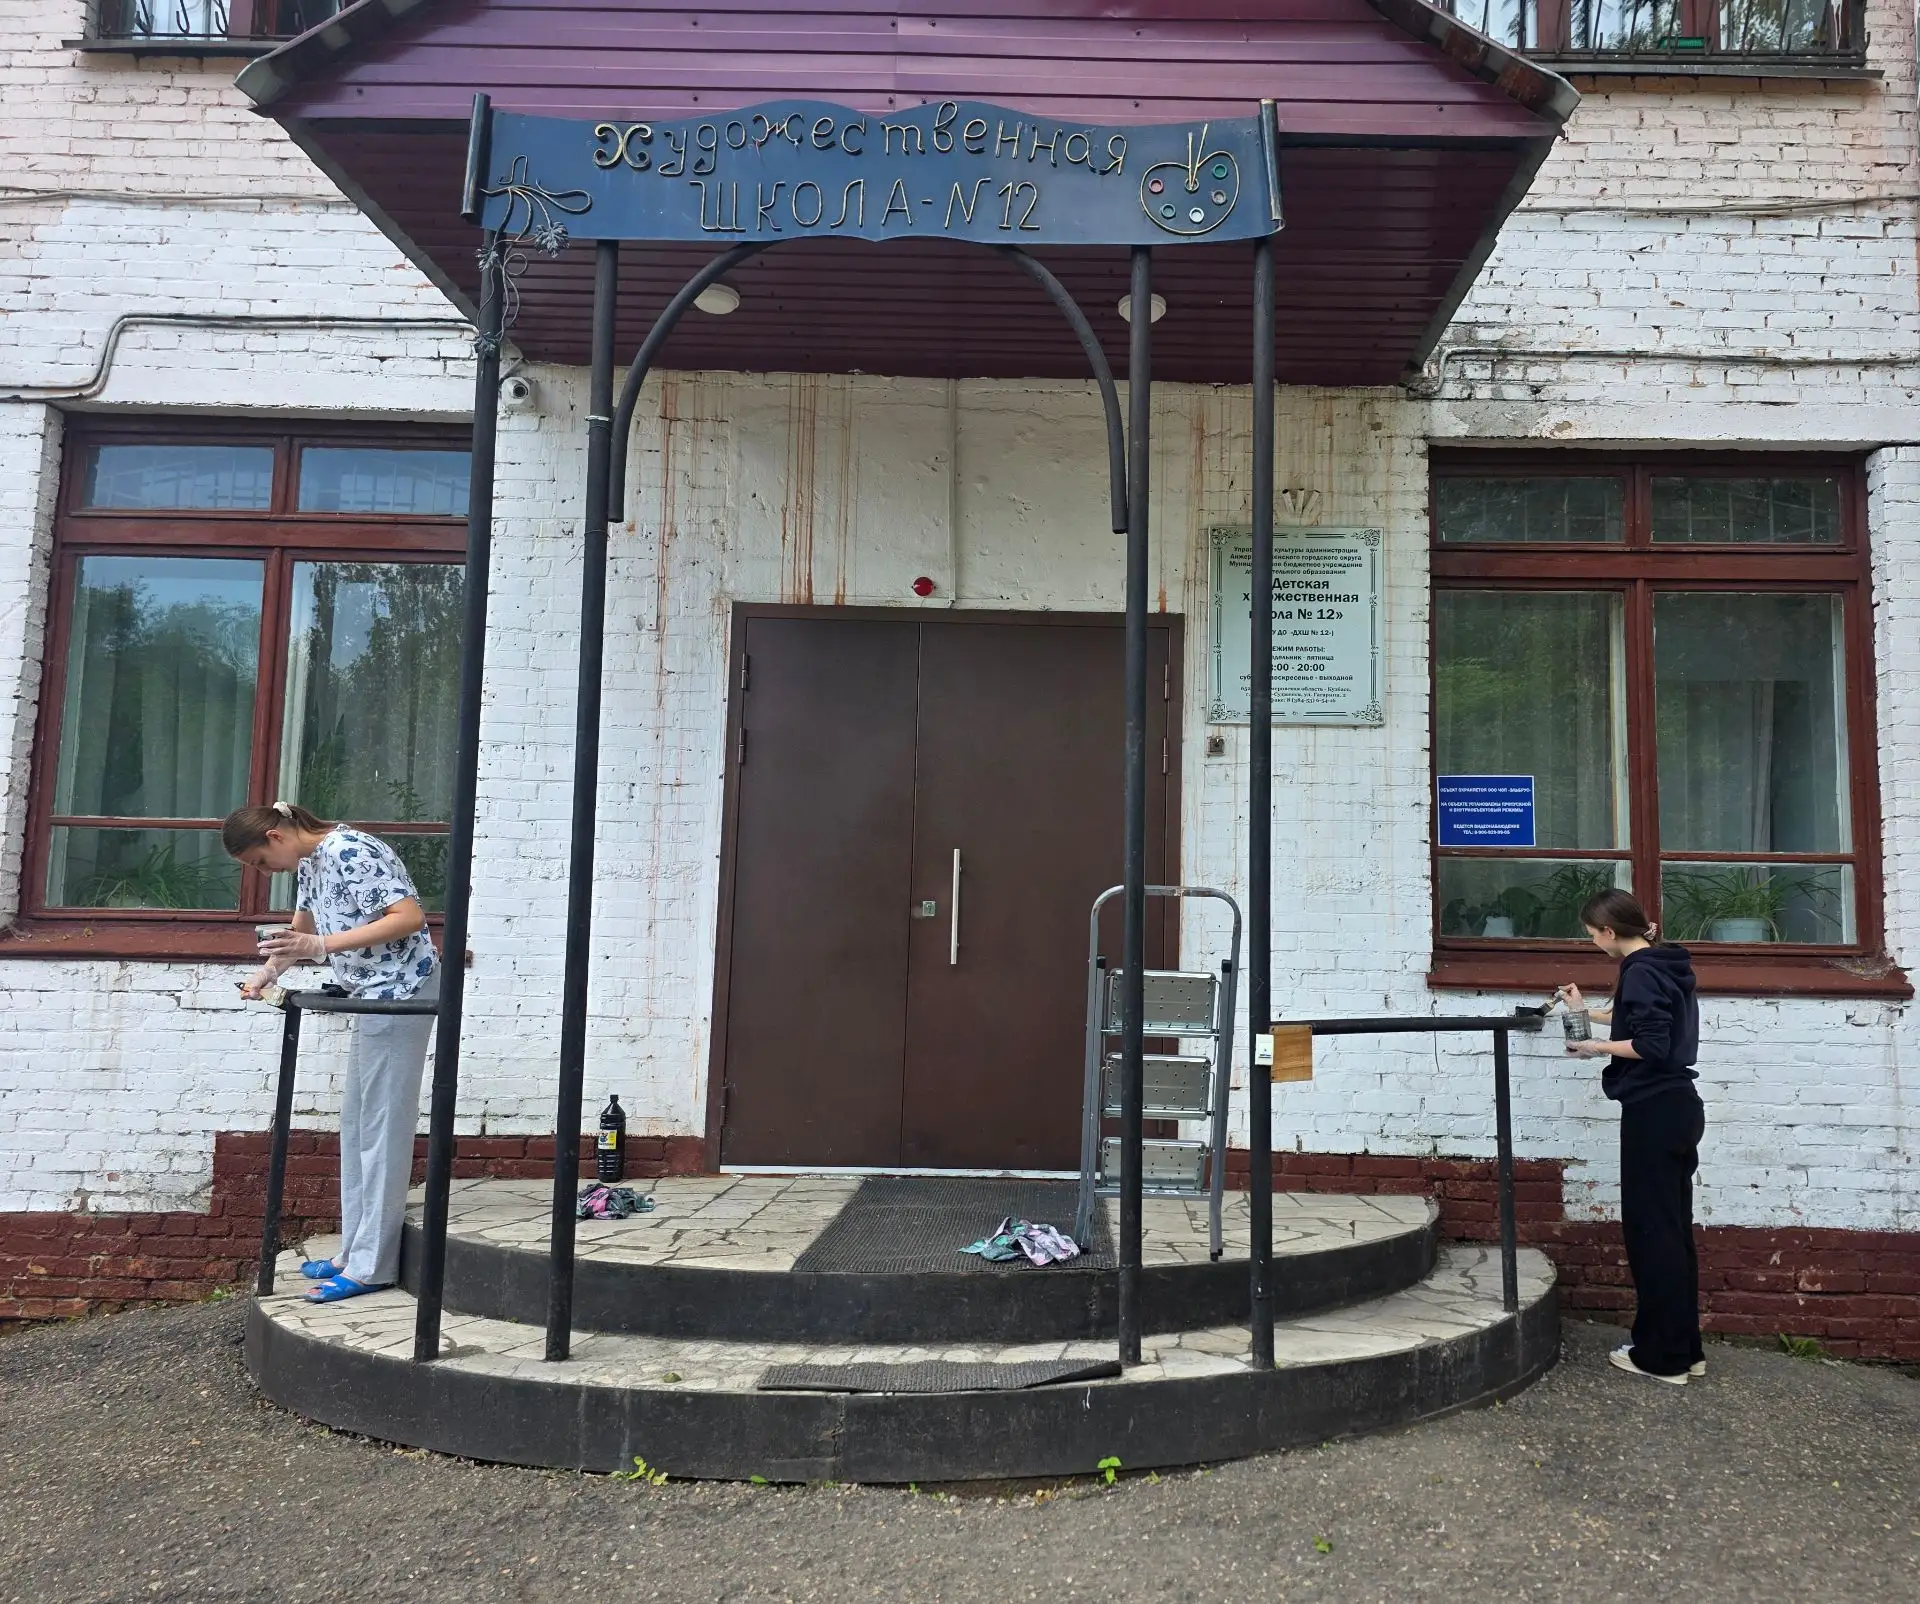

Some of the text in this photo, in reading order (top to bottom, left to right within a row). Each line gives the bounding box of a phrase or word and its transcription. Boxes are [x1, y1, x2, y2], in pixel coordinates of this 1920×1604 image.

[592, 100, 1127, 177] Художественная
[1302, 554, 1338, 562] городского
[1298, 608, 1313, 620] №
[1317, 609, 1343, 620] 12»
[1297, 663, 1325, 672] 20:00
